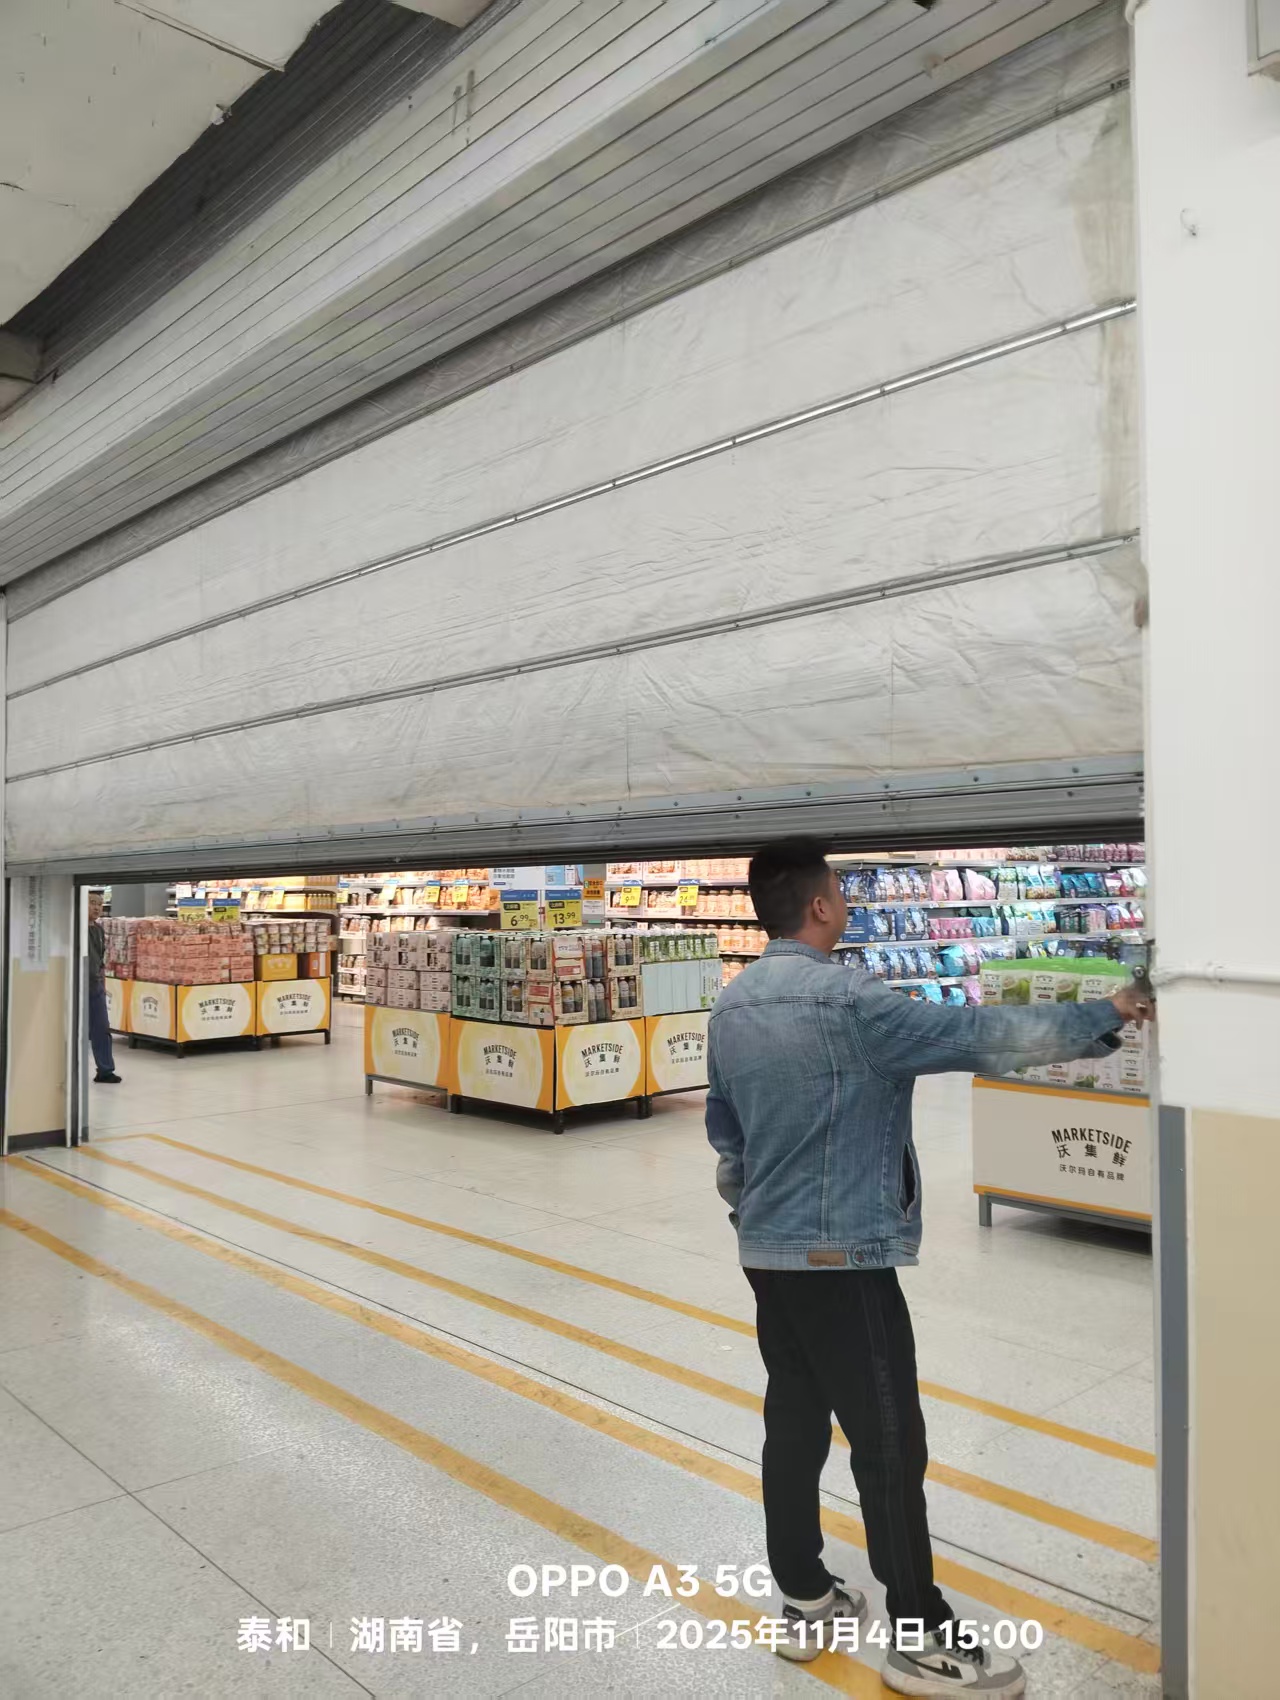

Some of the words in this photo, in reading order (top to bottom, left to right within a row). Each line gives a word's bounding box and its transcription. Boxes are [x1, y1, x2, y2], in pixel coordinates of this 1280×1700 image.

[510, 914, 529, 927] 6.99
[553, 911, 576, 925] 13.99
[198, 998, 236, 1008] MARKETSIDE
[392, 1027, 420, 1041] MARKETSIDE
[667, 1032, 706, 1047] MARKETSIDE
[483, 1044, 517, 1060] MARKETSIDE
[581, 1042, 624, 1058] MARKETSIDE
[1051, 1127, 1132, 1154] MARKETSIDE
[1056, 1143, 1127, 1167] 沃集鲜
[1059, 1163, 1125, 1181] 沃尔玛自有品牌
